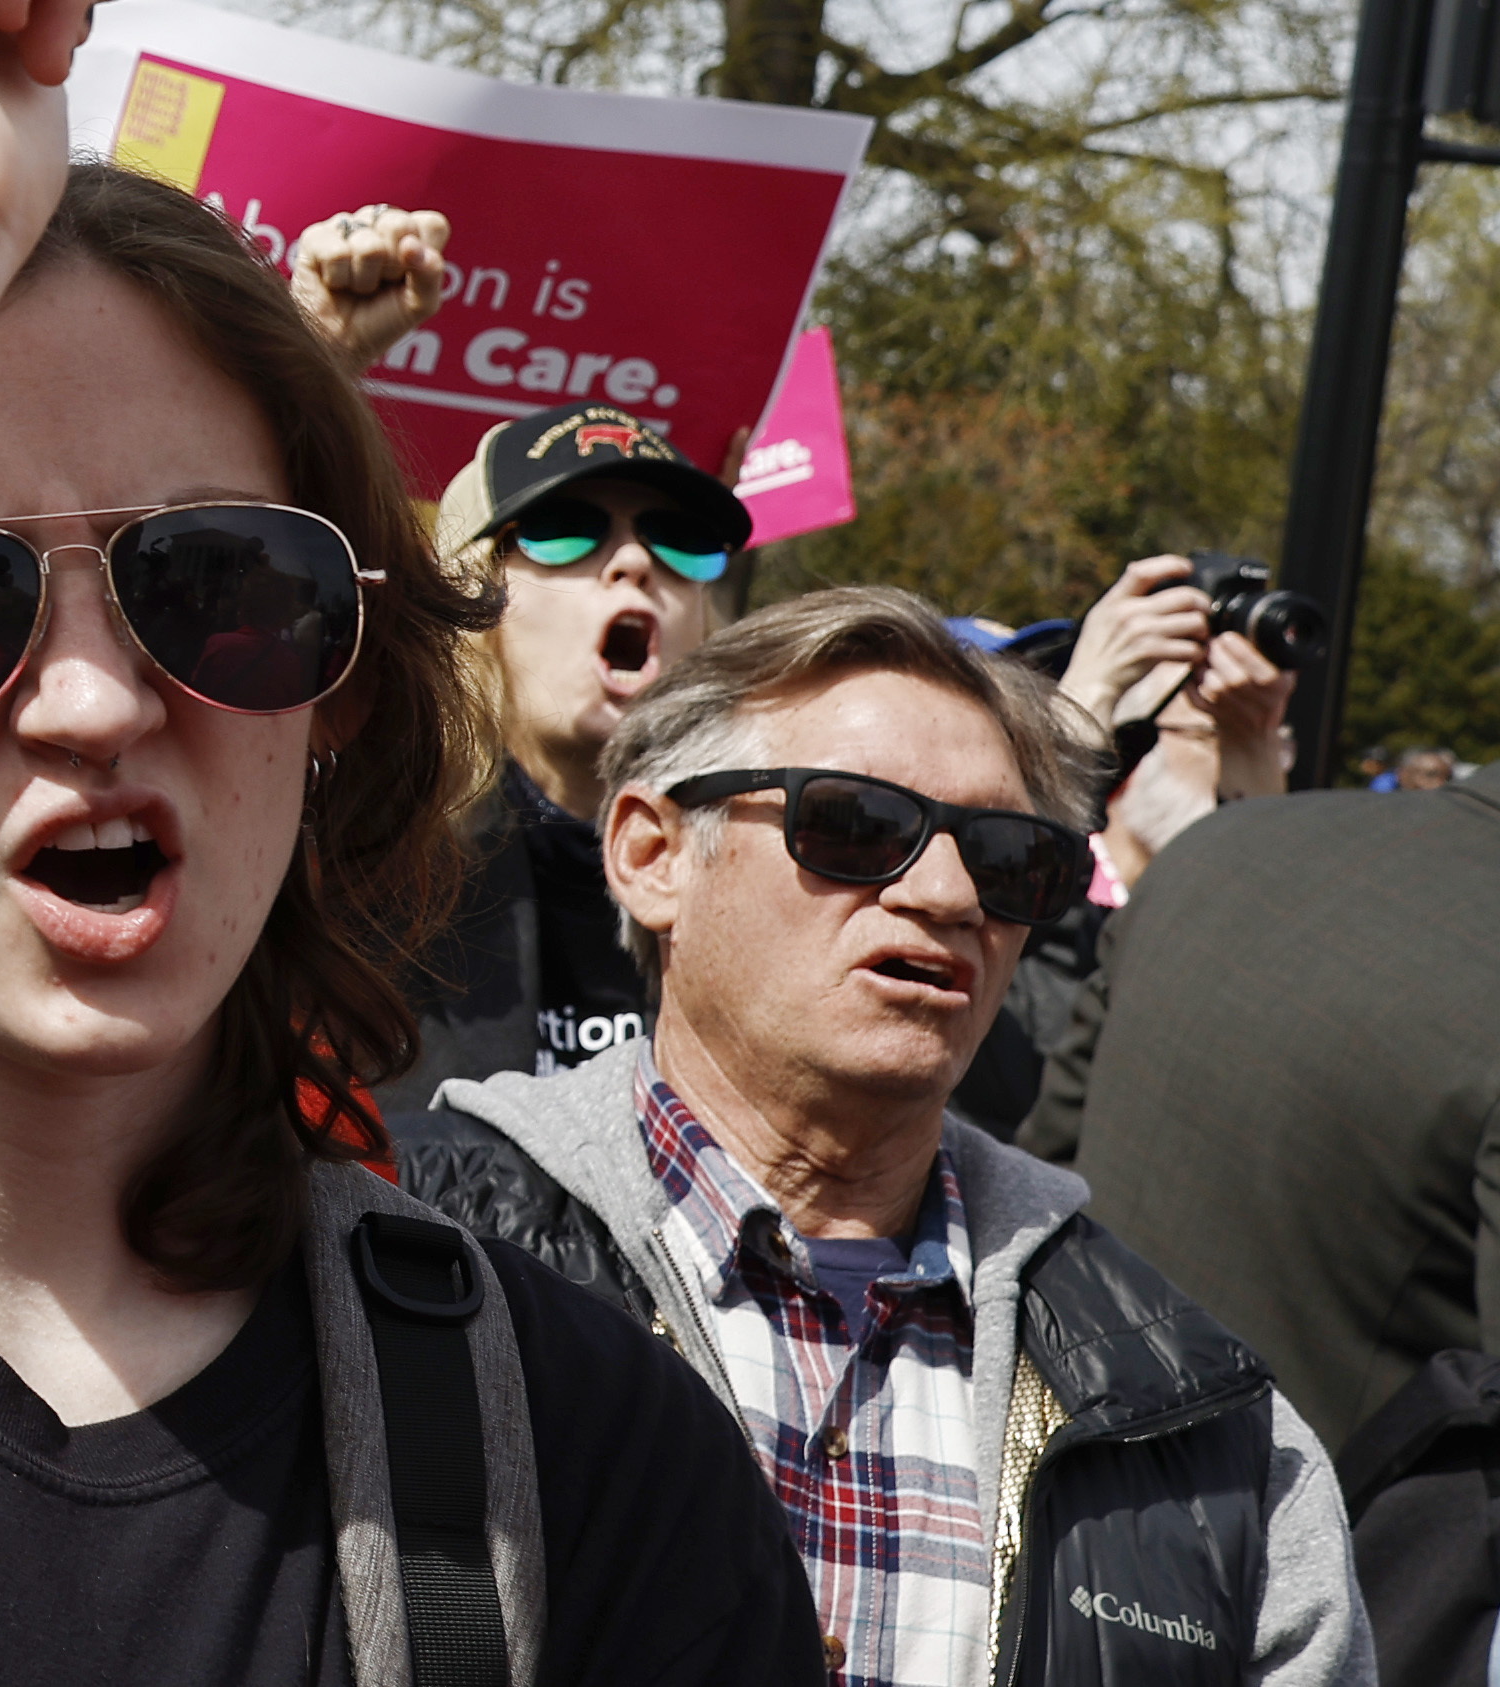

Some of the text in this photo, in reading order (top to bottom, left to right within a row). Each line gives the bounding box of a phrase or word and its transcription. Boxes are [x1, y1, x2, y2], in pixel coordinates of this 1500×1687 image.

[533, 260, 592, 320] is
[463, 327, 680, 408] Care.
[739, 438, 812, 481] are.
[1092, 1592, 1217, 1650] Columbia
